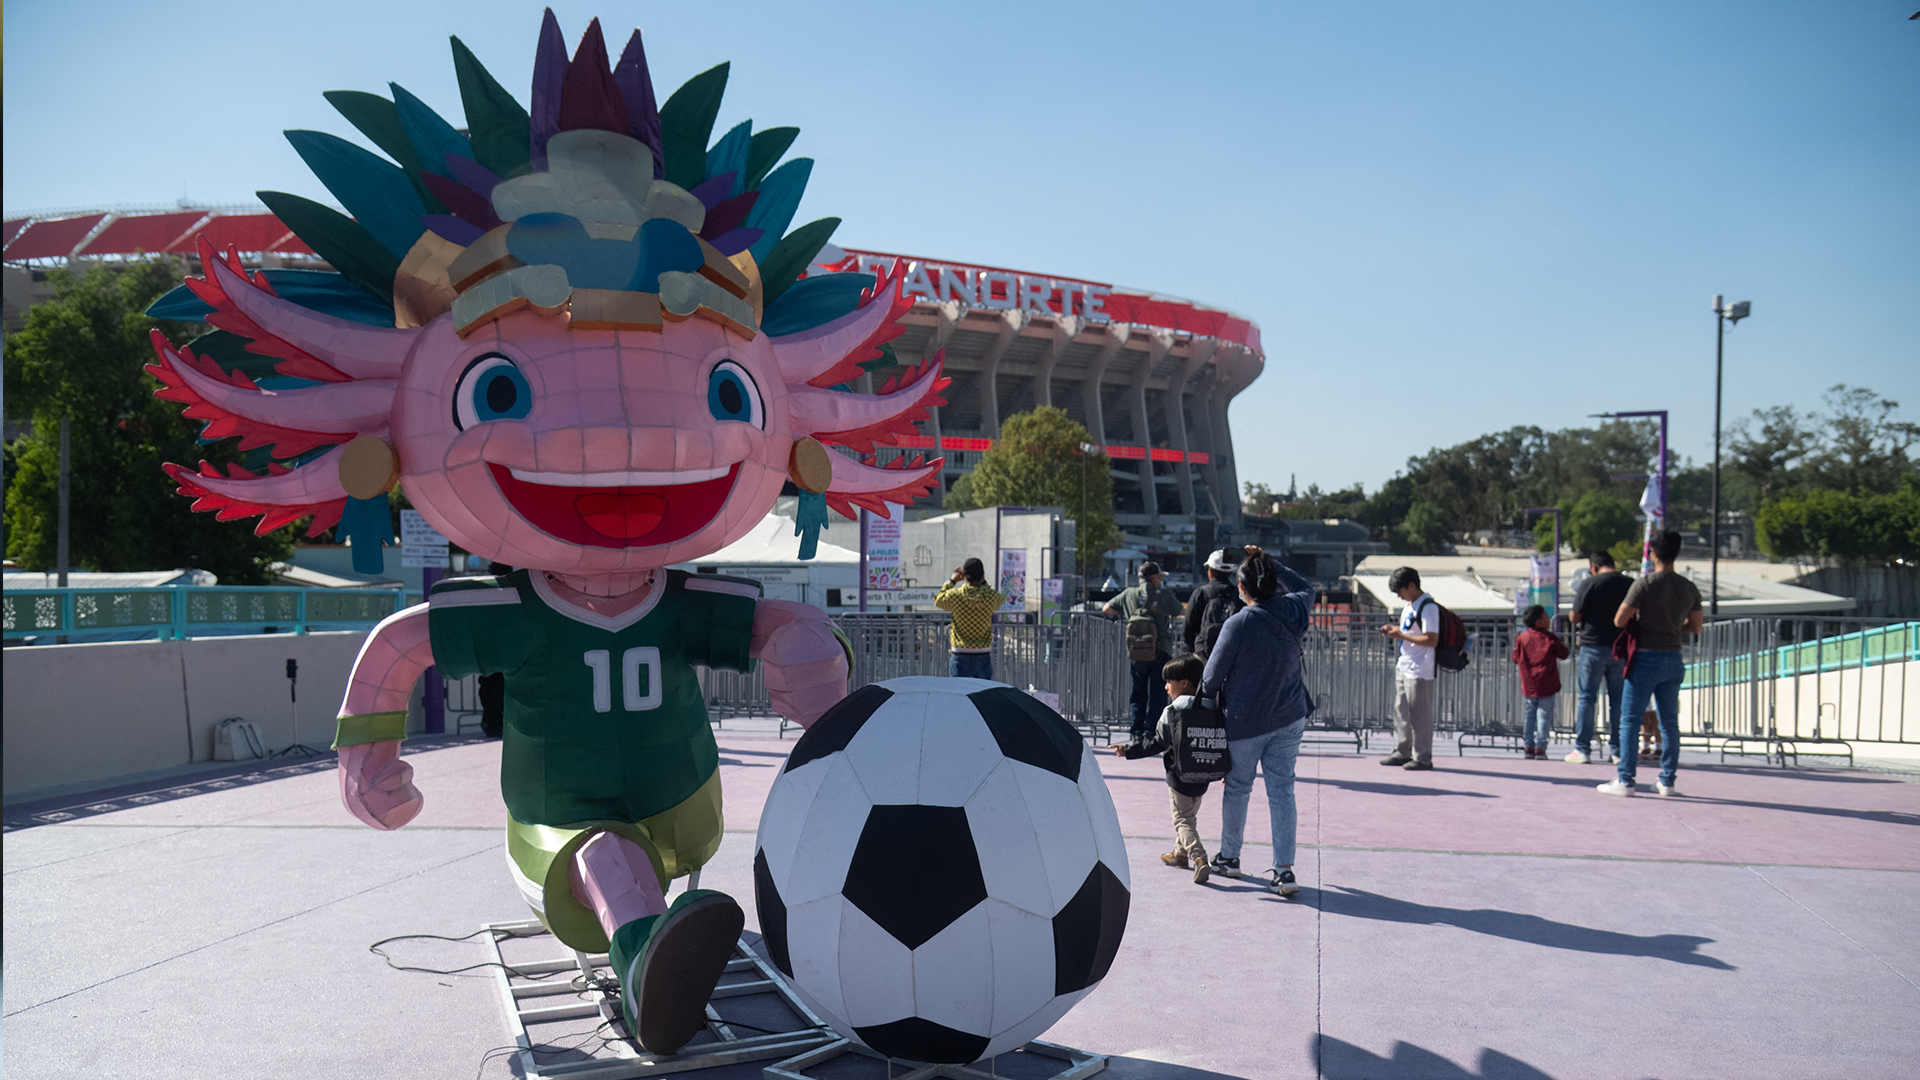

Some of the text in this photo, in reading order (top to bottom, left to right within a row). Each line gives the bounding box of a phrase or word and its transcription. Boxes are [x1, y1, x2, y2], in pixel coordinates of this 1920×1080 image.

[898, 592, 929, 600] Cubierto
[583, 646, 663, 713] 10
[1187, 727, 1215, 738] CUIDADO
[1198, 738, 1206, 748] EL
